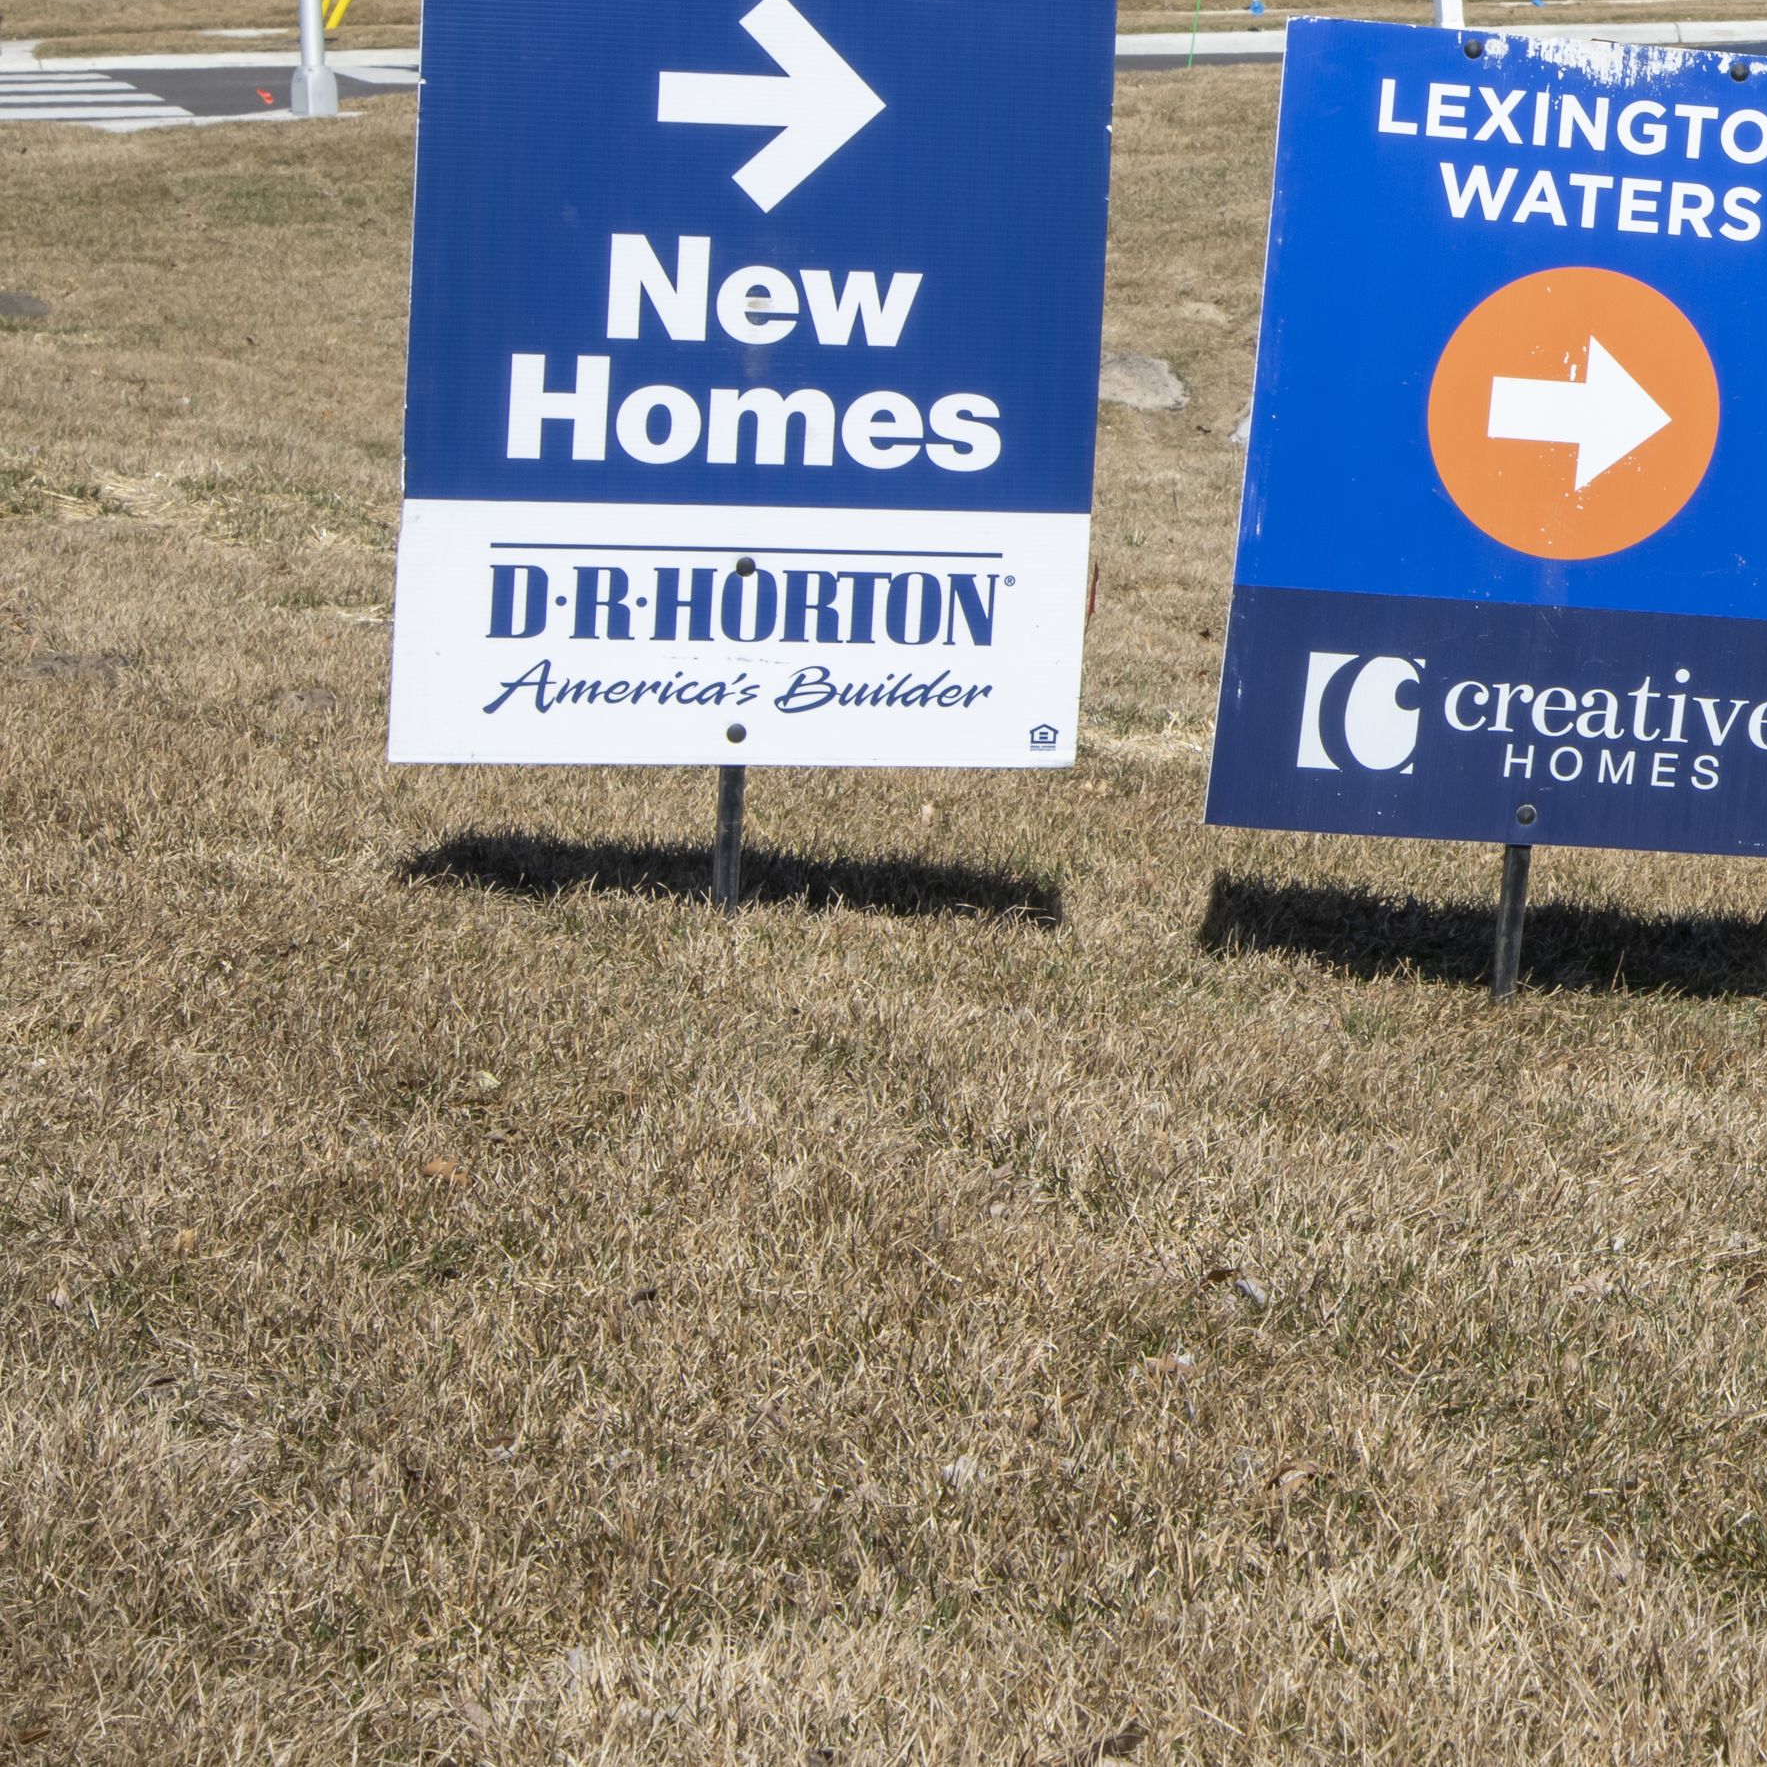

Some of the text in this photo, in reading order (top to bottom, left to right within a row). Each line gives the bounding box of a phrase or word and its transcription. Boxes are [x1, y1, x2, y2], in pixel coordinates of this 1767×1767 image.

[1439, 162, 1763, 243] WATERS
[606, 233, 923, 347] New
[506, 353, 1002, 472] Homes
[483, 658, 993, 716] America's Builder
[1503, 744, 1721, 790] HOMES
